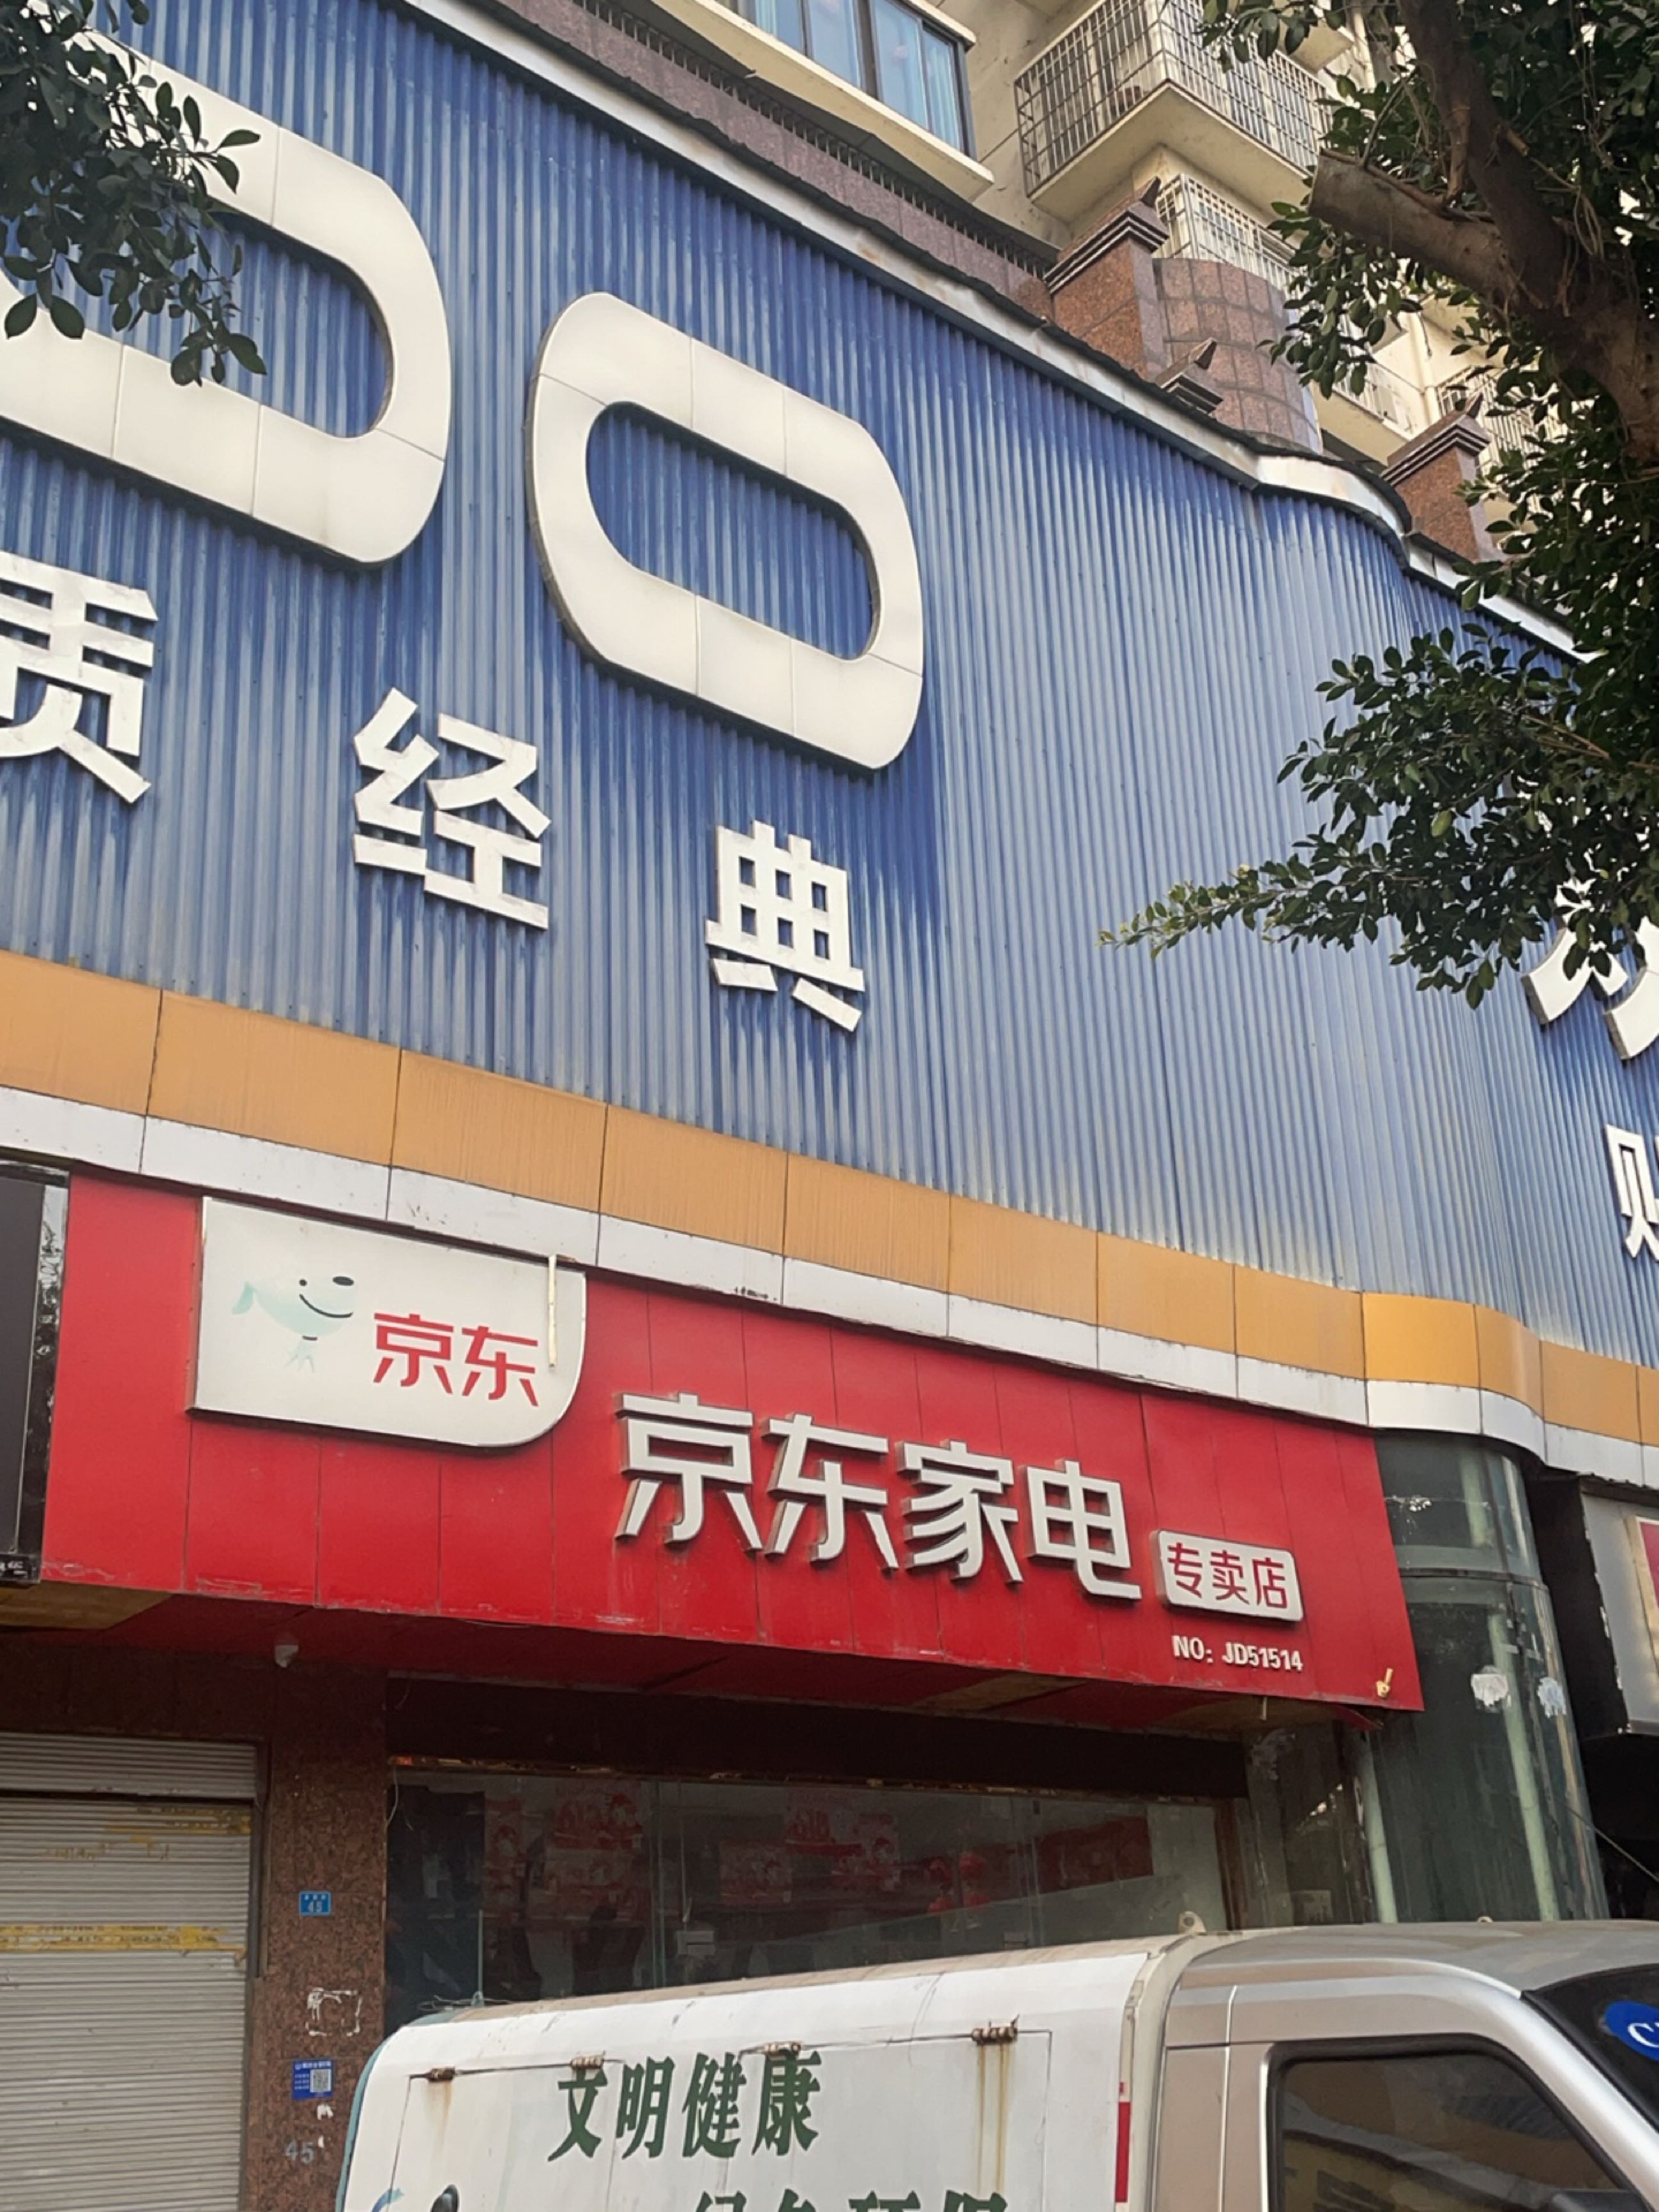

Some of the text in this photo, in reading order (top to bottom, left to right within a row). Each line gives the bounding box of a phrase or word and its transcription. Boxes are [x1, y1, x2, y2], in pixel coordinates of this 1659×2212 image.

[373, 1313, 539, 1407] 京东
[614, 1391, 1141, 1600] 京东家电
[1167, 1543, 1287, 1608] 专卖店
[1222, 1642, 1304, 1671] JD51514
[547, 2049, 822, 2162] 文明健康
